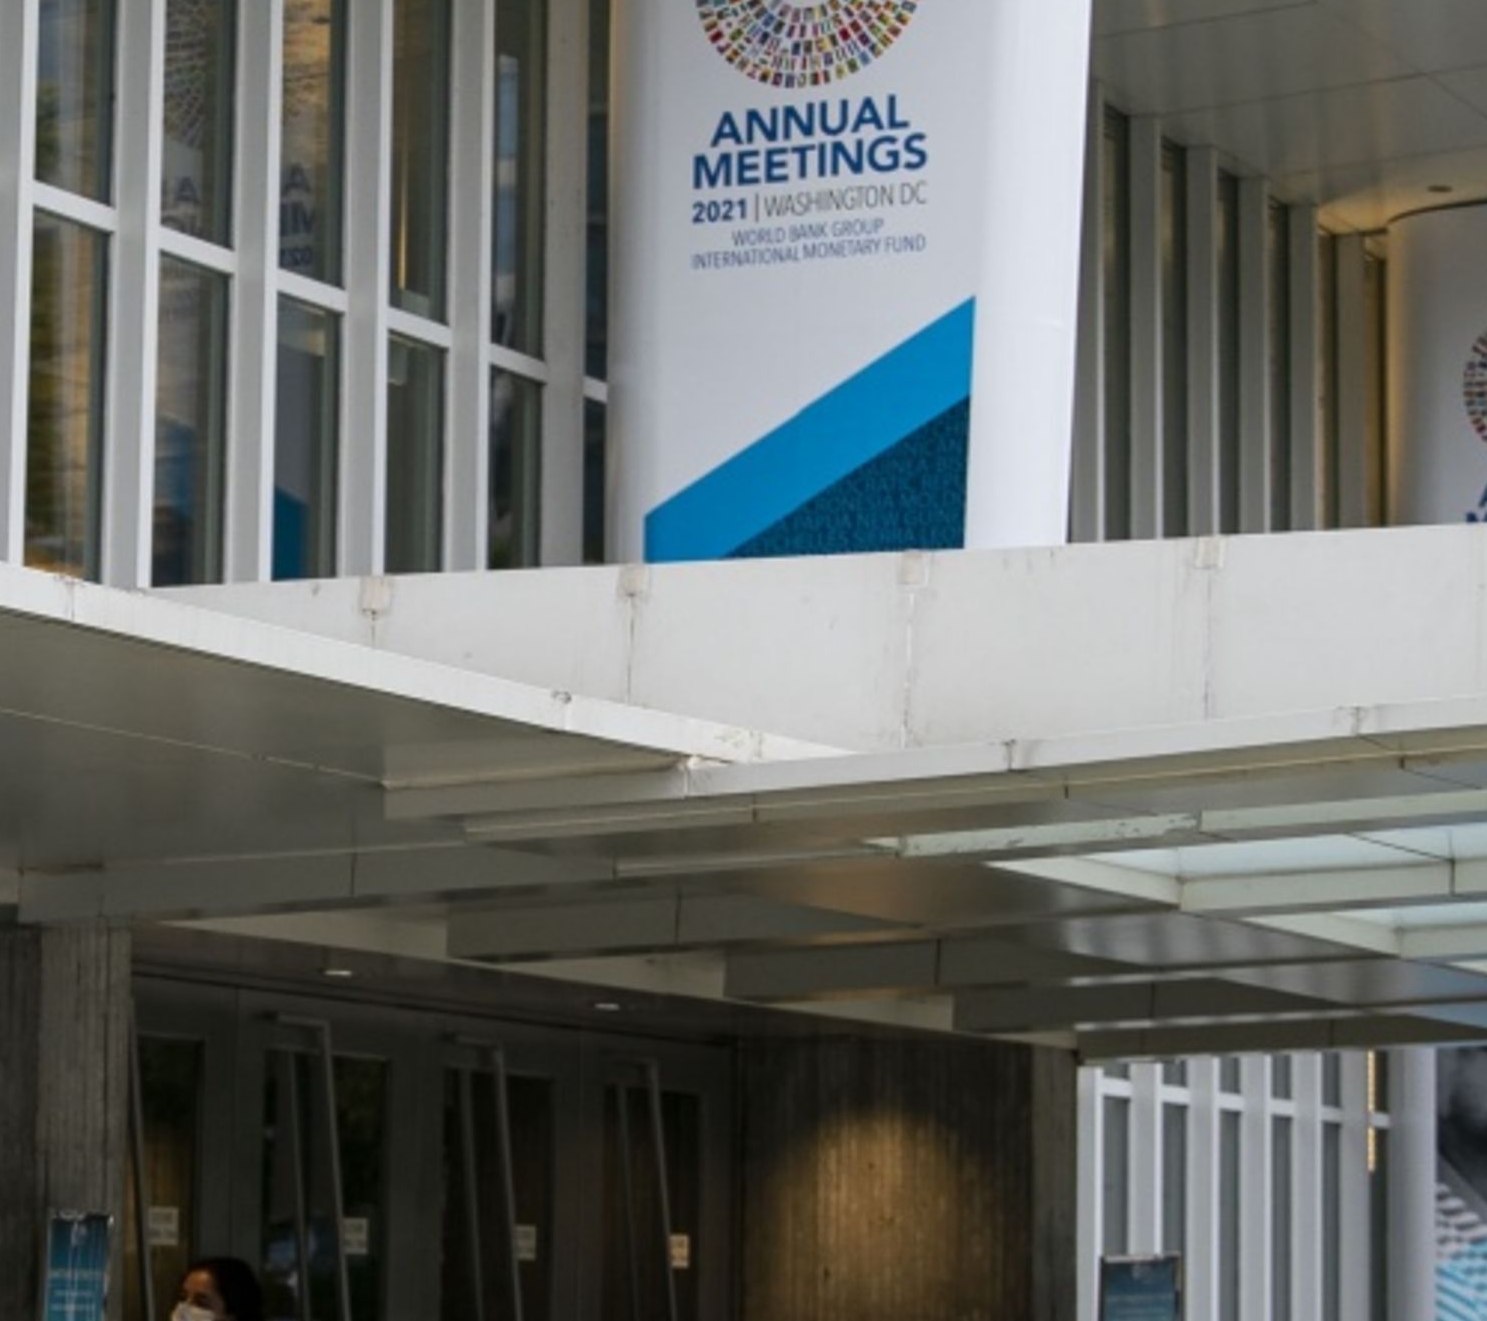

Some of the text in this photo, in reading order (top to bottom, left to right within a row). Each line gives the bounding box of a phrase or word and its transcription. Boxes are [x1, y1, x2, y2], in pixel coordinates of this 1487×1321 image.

[711, 94, 910, 148] ANNUAL
[692, 132, 929, 190] MEETINGS
[692, 181, 928, 224] 2021 WASHINGTON DC
[691, 234, 927, 270] INTERNATIONAL MONETARY FUND
[731, 217, 885, 248] WORLD BANK GROUP
